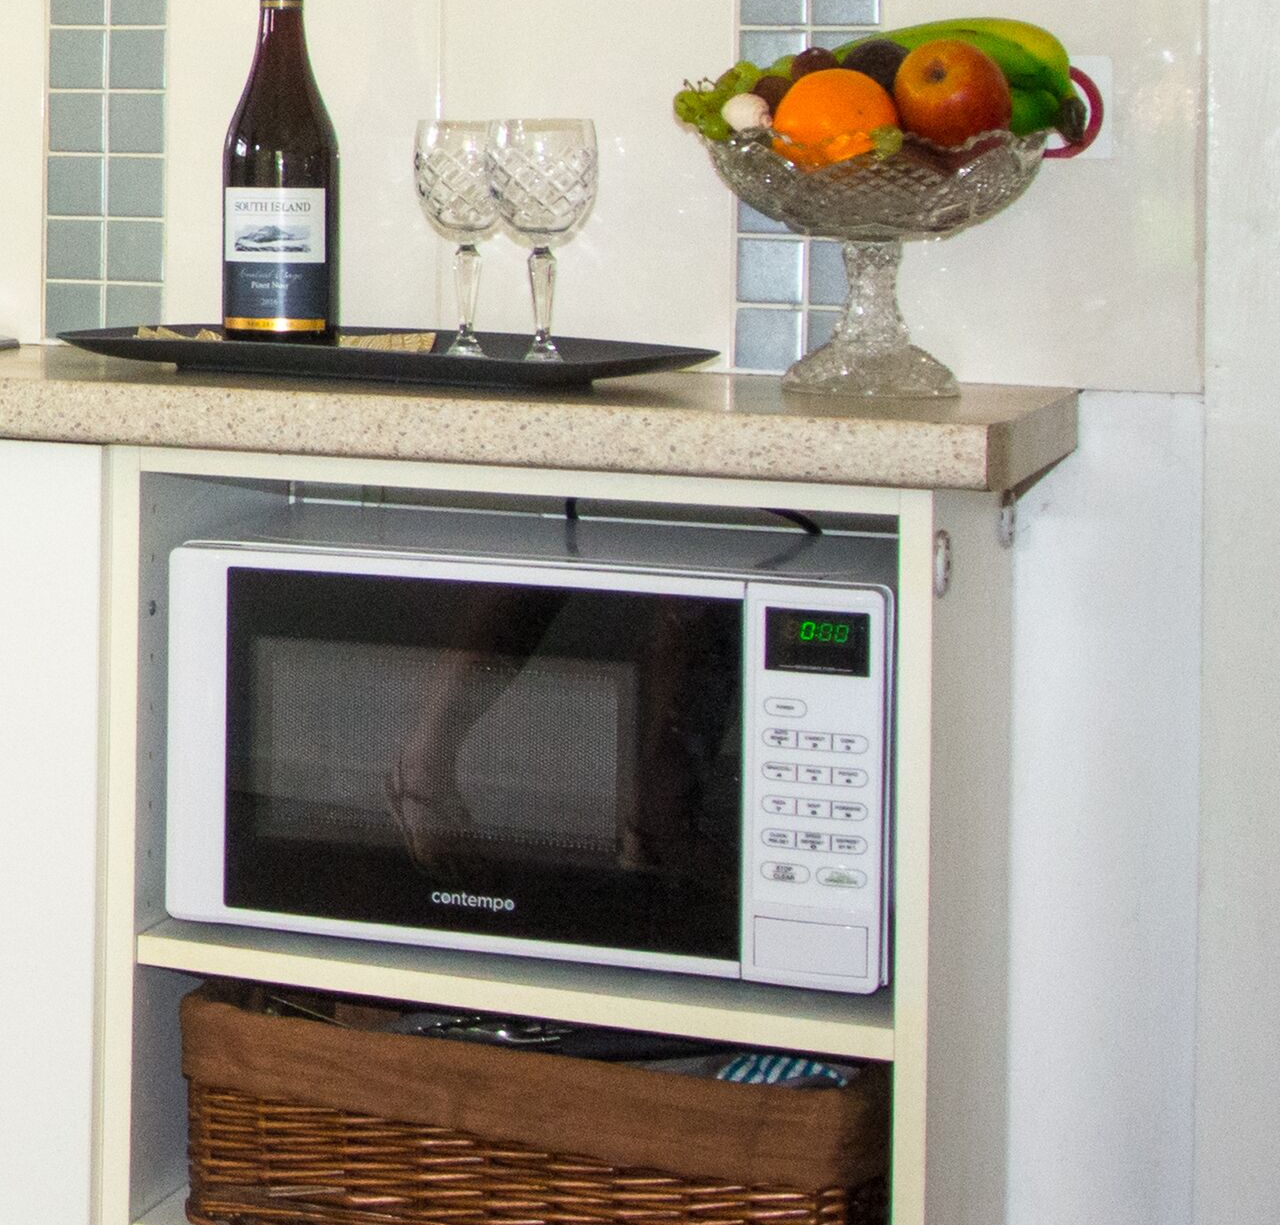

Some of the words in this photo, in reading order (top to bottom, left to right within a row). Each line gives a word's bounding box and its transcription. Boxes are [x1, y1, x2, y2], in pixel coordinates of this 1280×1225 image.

[235, 201, 268, 212] SOUTH
[271, 201, 311, 213] ISLAND
[800, 620, 849, 644] 0:00
[431, 890, 515, 913] contempo
